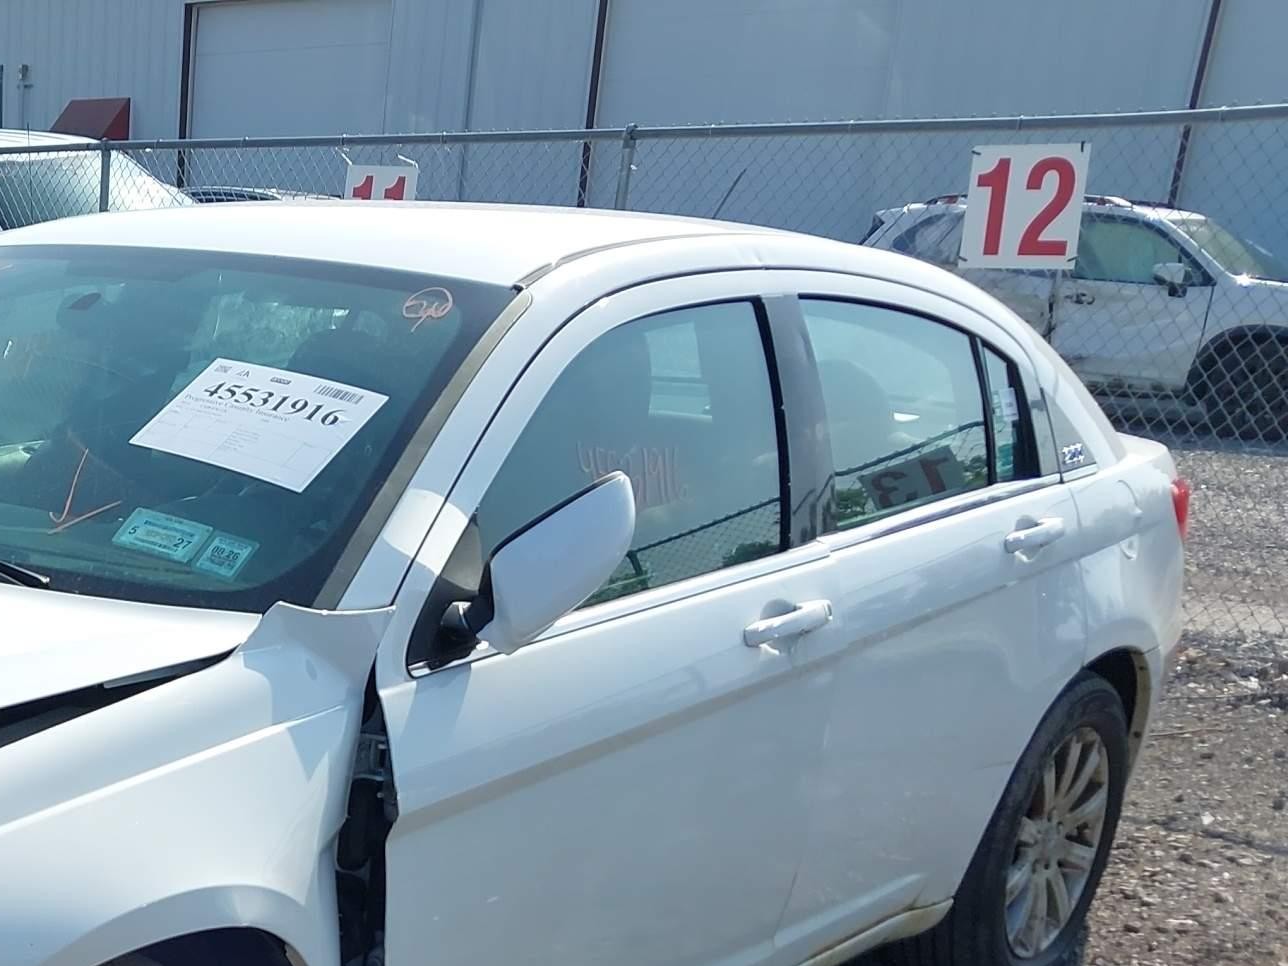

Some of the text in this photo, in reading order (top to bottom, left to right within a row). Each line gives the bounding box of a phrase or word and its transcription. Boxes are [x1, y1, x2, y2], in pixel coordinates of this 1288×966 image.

[976, 156, 1076, 256] 12
[204, 381, 346, 427] 45531916
[128, 524, 140, 535] 5
[172, 536, 193, 550] 27
